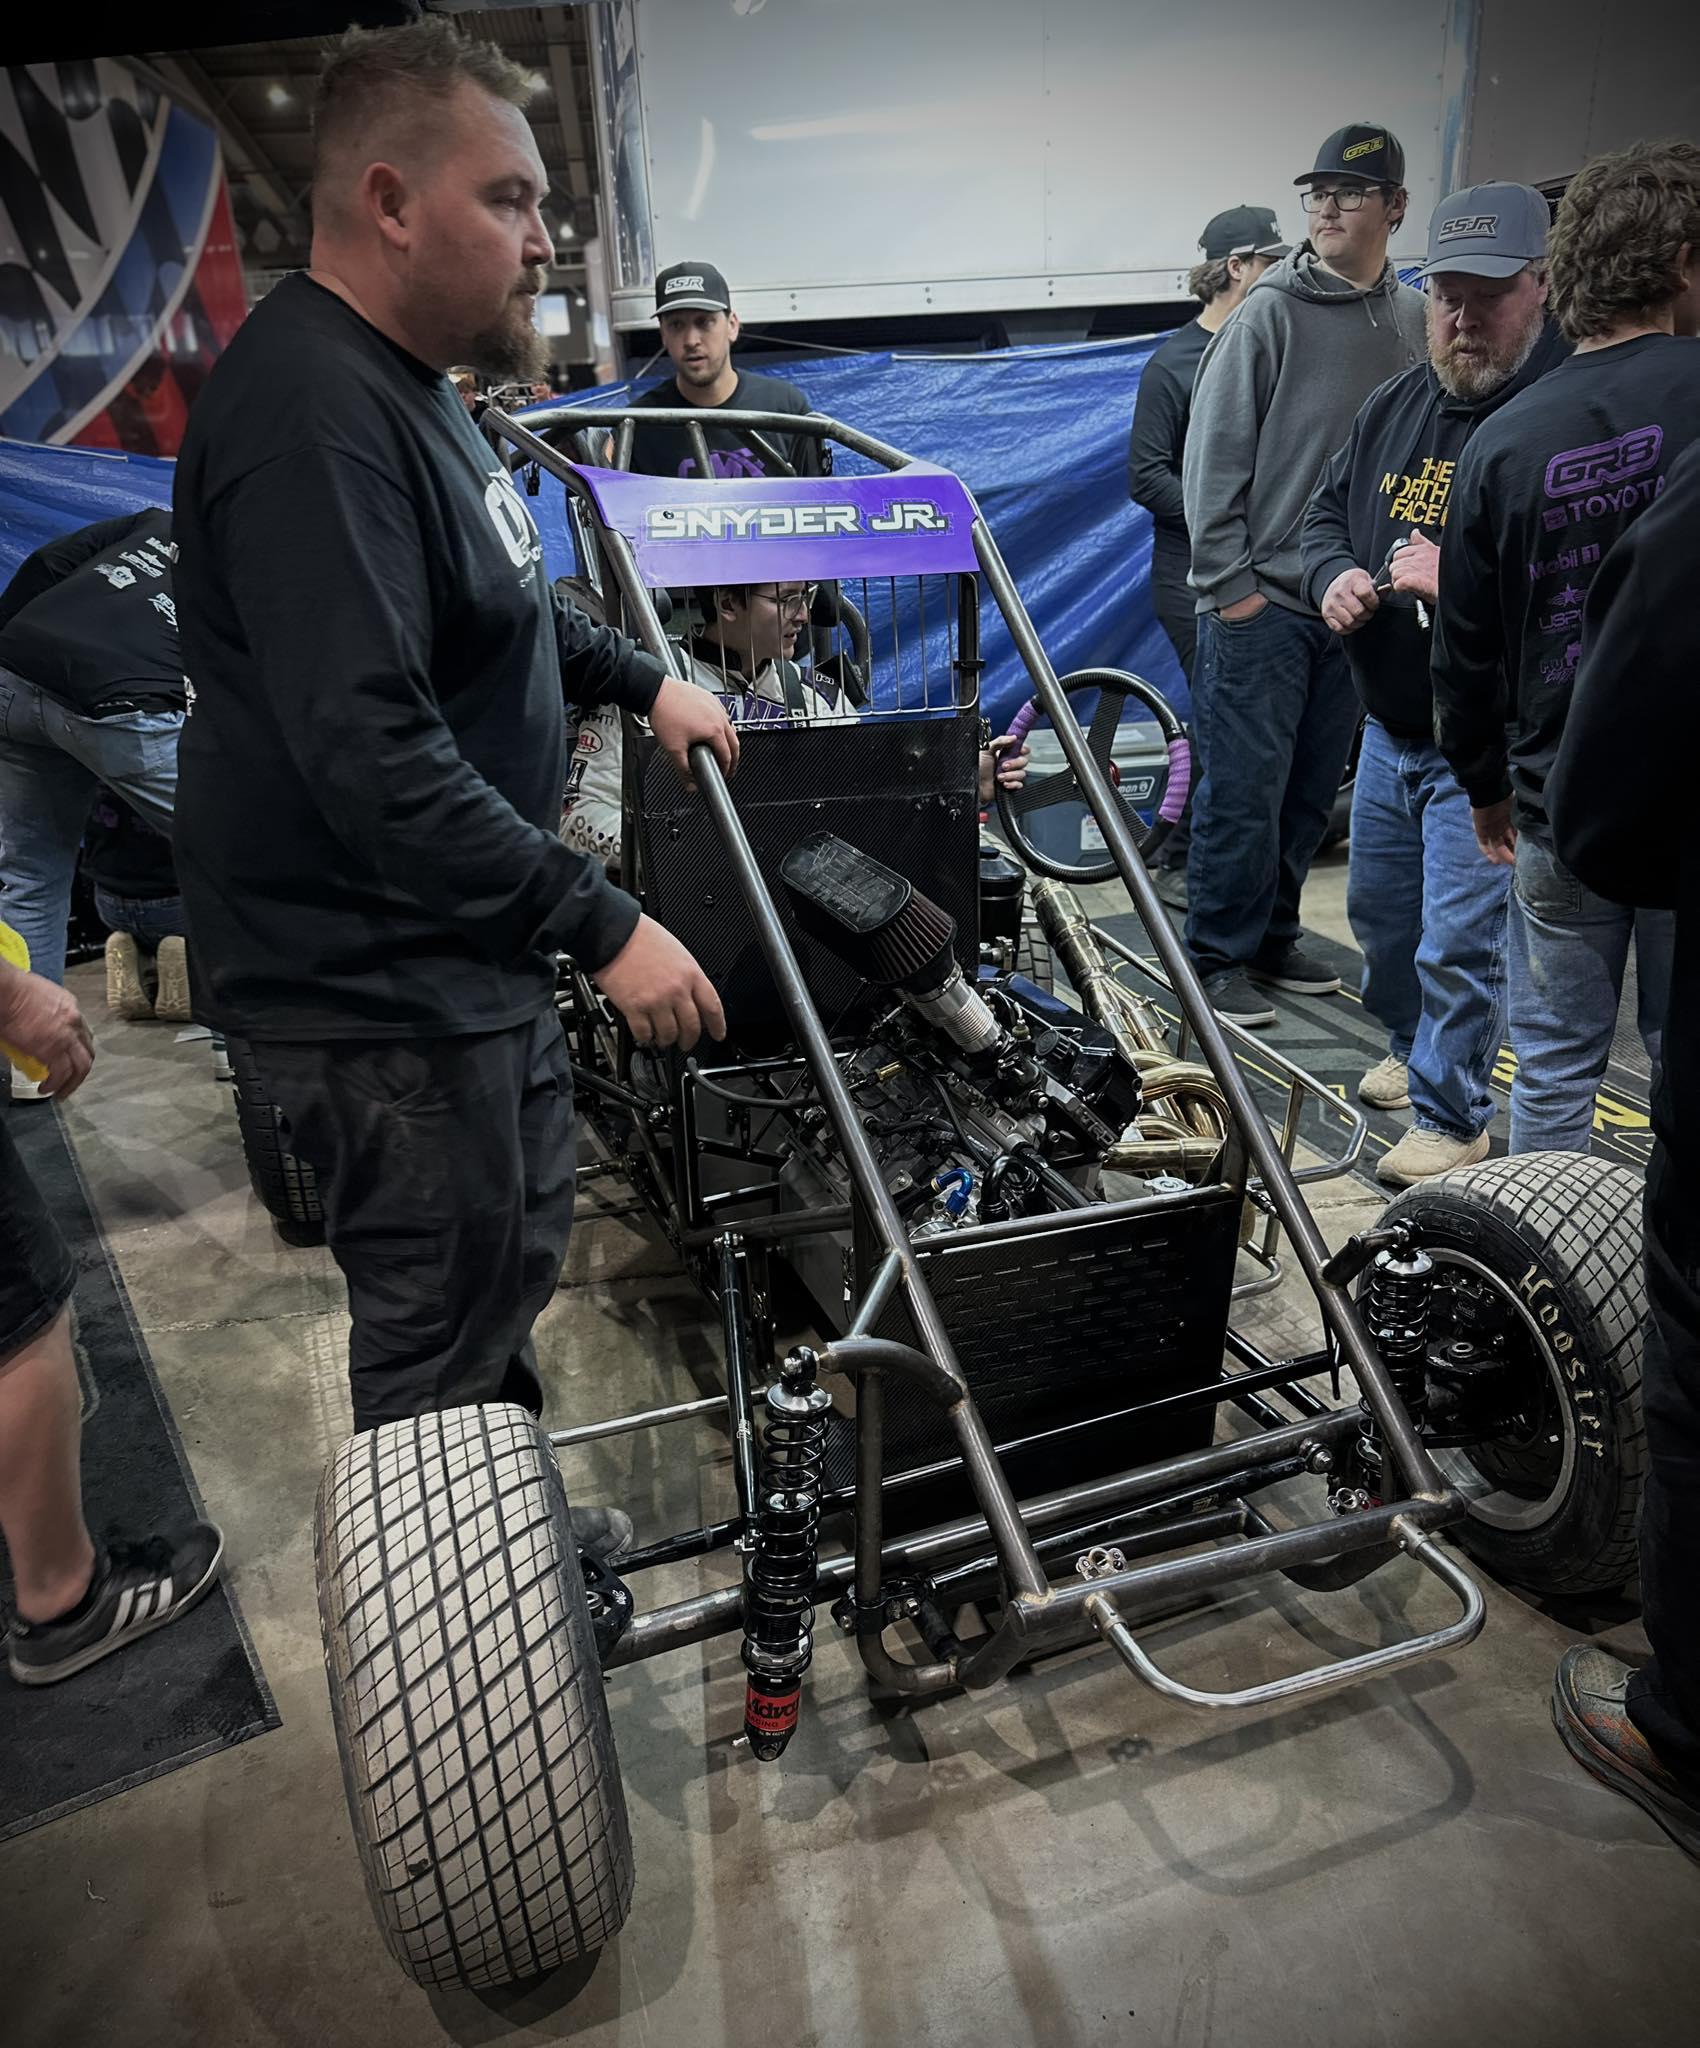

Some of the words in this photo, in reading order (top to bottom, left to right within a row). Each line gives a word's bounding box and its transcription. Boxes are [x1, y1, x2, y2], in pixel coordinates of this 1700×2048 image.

[1421, 457, 1456, 484] THE
[1550, 433, 1659, 491] GR8
[1378, 473, 1450, 505] NORTH
[1569, 476, 1665, 522] TOYOTA
[651, 505, 859, 539] SNYDER
[872, 503, 945, 531] JR.
[1389, 497, 1442, 526] FACE
[1529, 548, 1579, 582] Mobil
